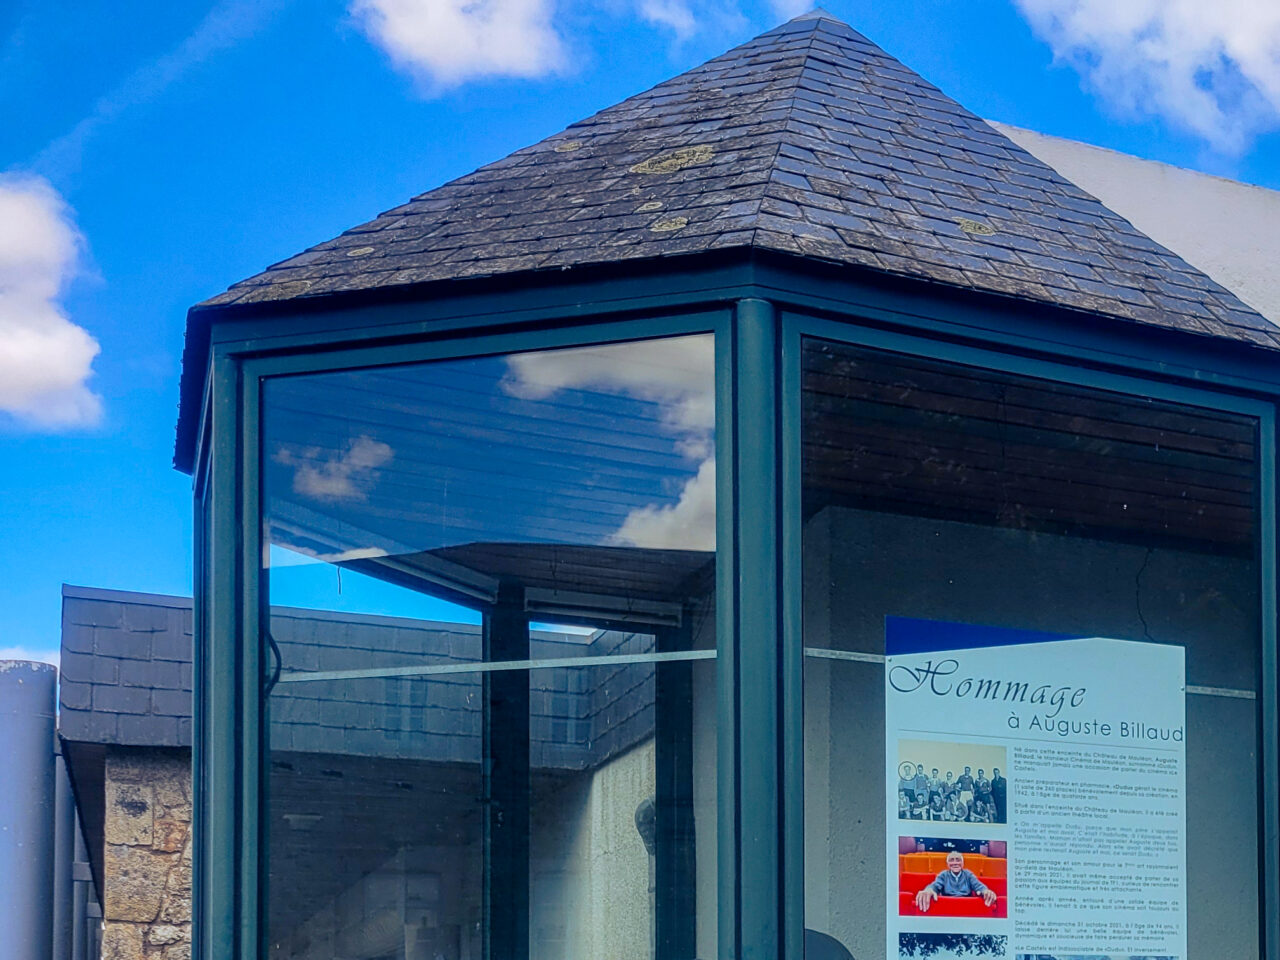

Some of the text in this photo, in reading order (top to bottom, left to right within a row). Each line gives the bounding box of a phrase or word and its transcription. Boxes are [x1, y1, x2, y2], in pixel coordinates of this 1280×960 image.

[888, 659, 1087, 719] Hommage
[1007, 711, 1184, 742] à Auguste Billaud
